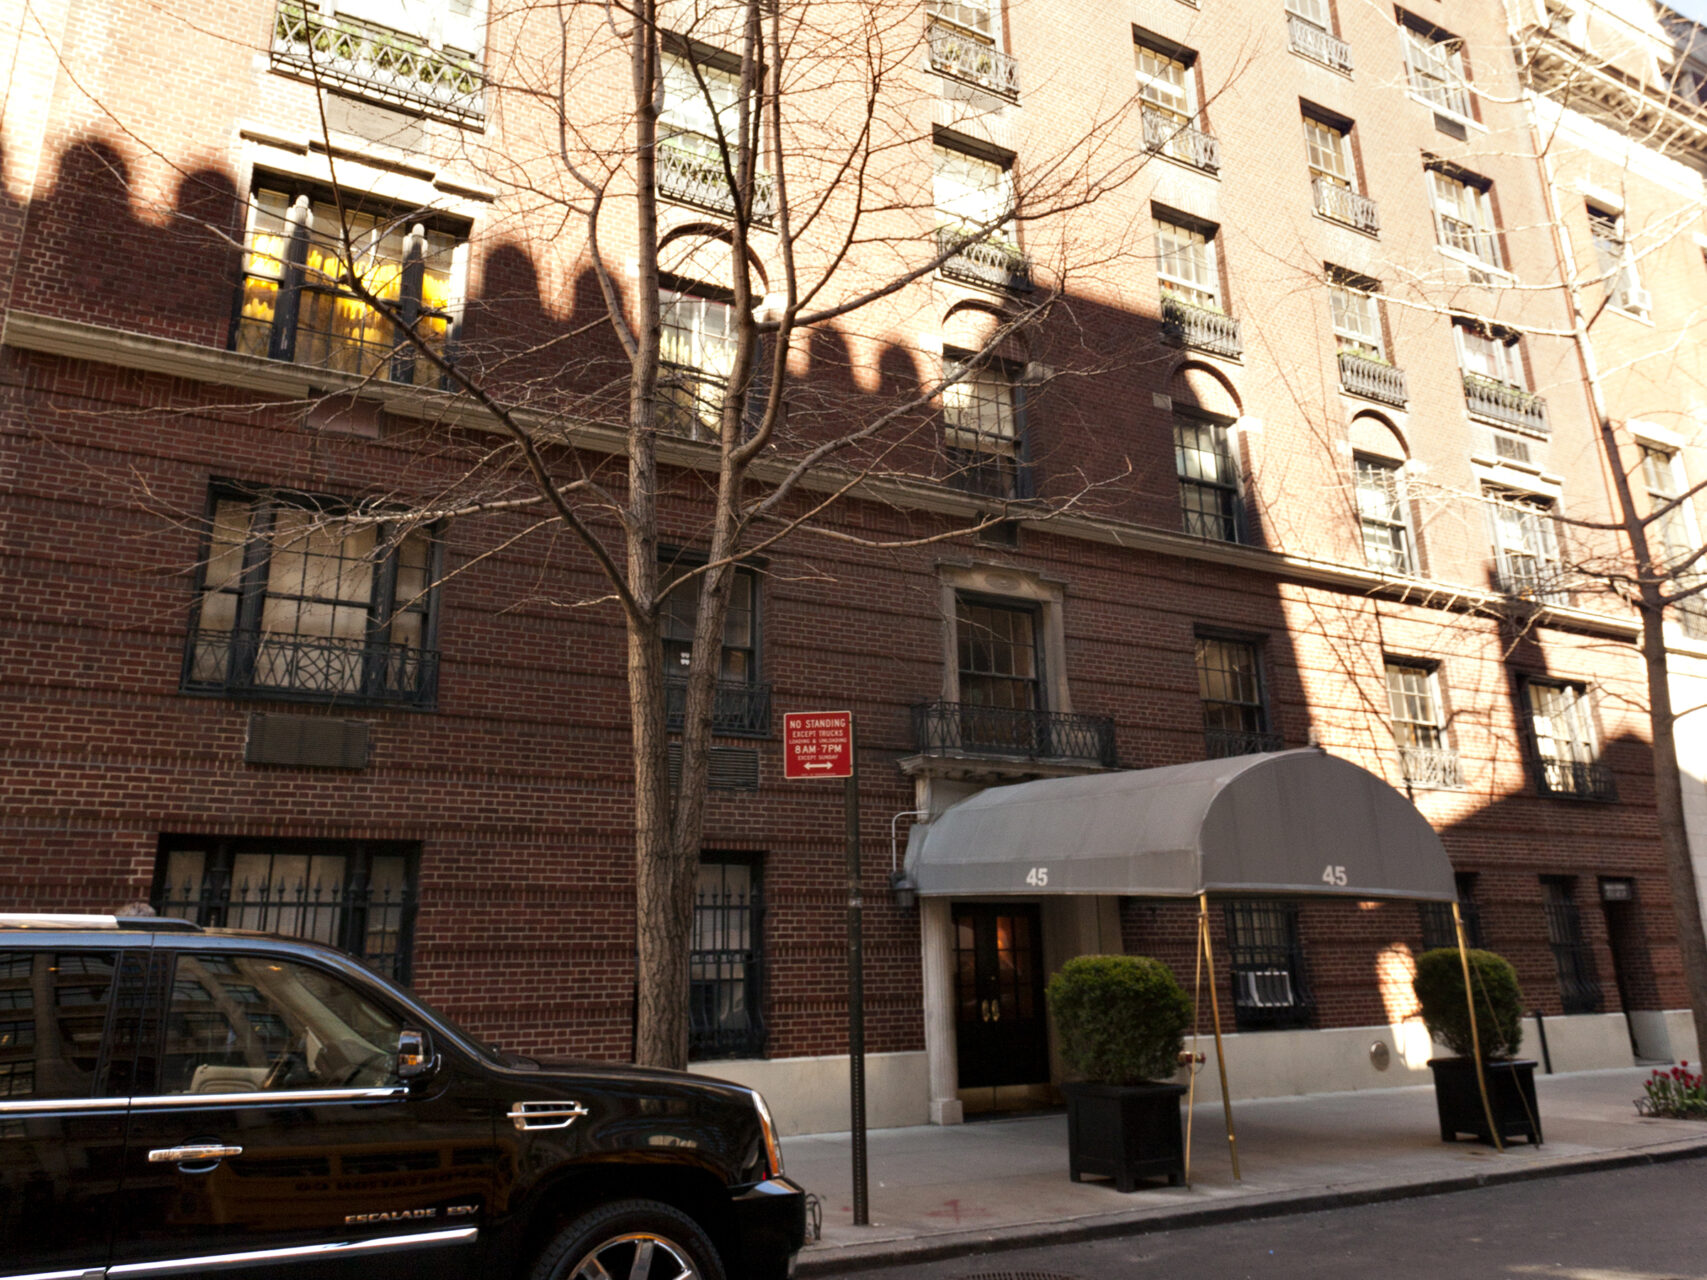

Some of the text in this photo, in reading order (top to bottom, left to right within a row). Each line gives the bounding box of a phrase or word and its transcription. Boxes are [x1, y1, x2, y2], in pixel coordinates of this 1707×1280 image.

[790, 719, 846, 728] NO STANDING
[1026, 867, 1048, 887] 45
[1322, 864, 1348, 886] 45
[344, 1204, 479, 1224] ESCALADE ESV
